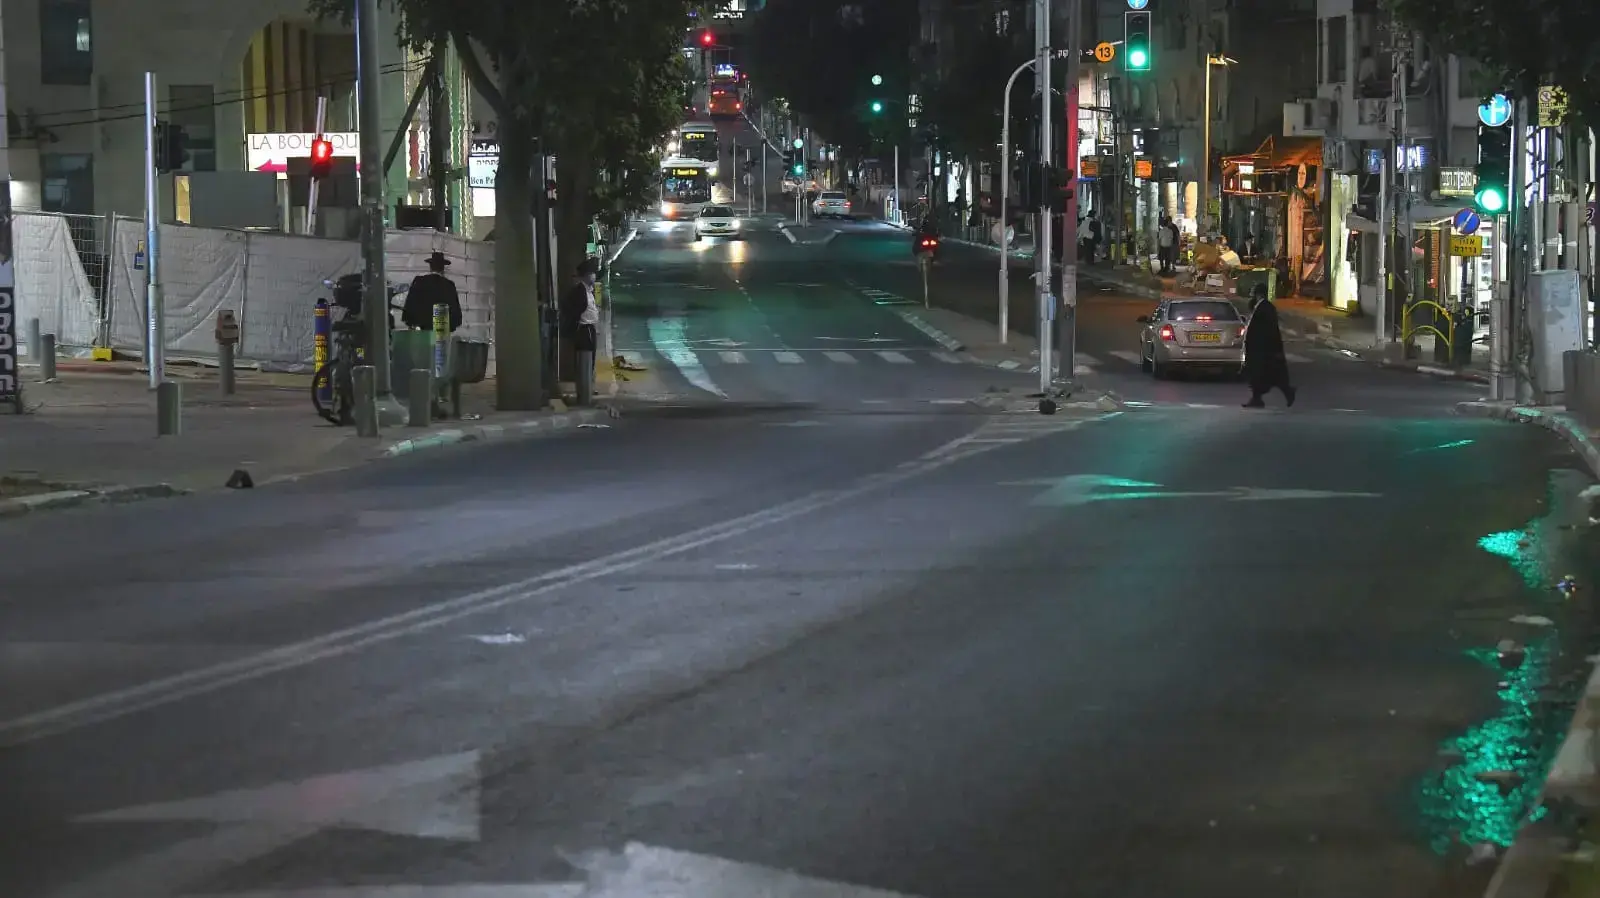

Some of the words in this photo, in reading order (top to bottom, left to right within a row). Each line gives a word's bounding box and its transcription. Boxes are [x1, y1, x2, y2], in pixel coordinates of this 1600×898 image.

[1098, 46, 1111, 58] 13
[252, 135, 272, 150] LA
[278, 134, 358, 150] BOUQU
[470, 176, 484, 185] Ben
